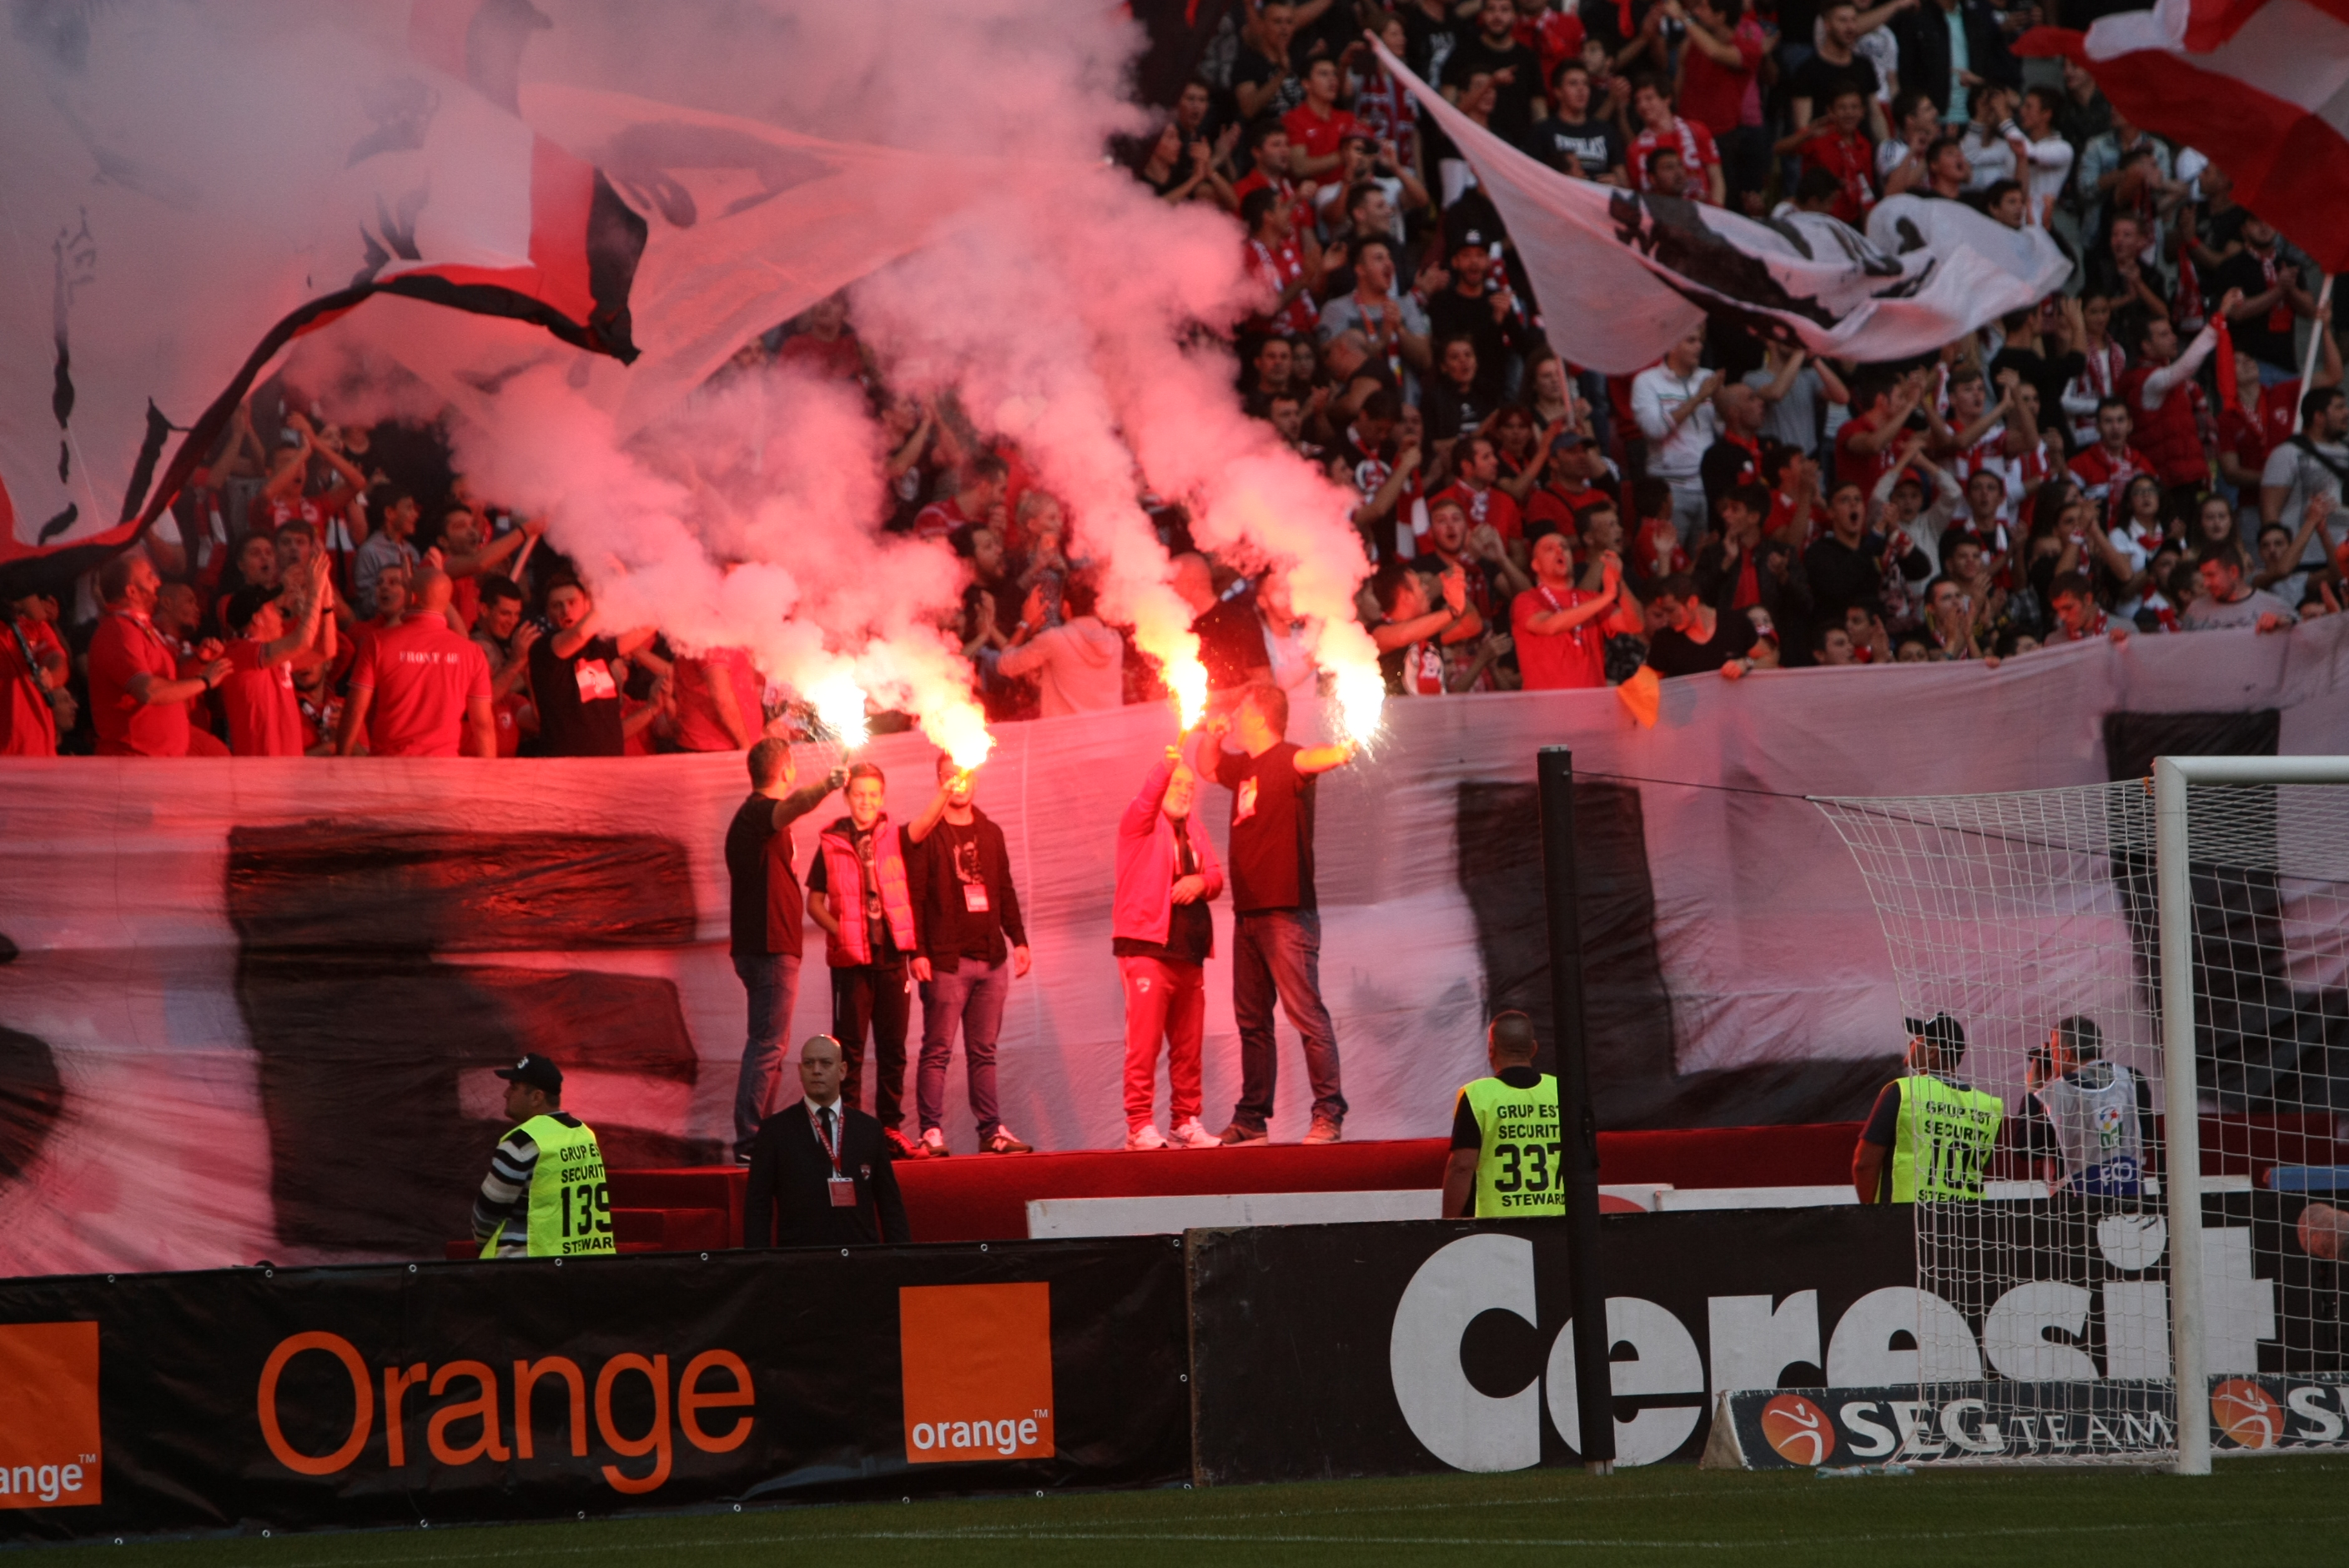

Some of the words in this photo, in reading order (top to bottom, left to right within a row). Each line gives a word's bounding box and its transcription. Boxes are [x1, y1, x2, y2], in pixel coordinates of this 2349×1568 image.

[1497, 1104, 1534, 1118] GRUP
[1924, 1120, 1989, 1143] SECURITY
[560, 1144, 586, 1162] GRUP
[1495, 1143, 1562, 1193] 337
[561, 1184, 612, 1237] 139
[562, 1237, 615, 1254] STEWAR
[1390, 1212, 2276, 1474] Ceresit
[257, 1330, 756, 1494] Orange
[913, 1418, 1038, 1455] orange
[1839, 1398, 2005, 1457] SEG
[2009, 1410, 2174, 1449] TEAM
[2287, 1386, 2349, 1440] S
